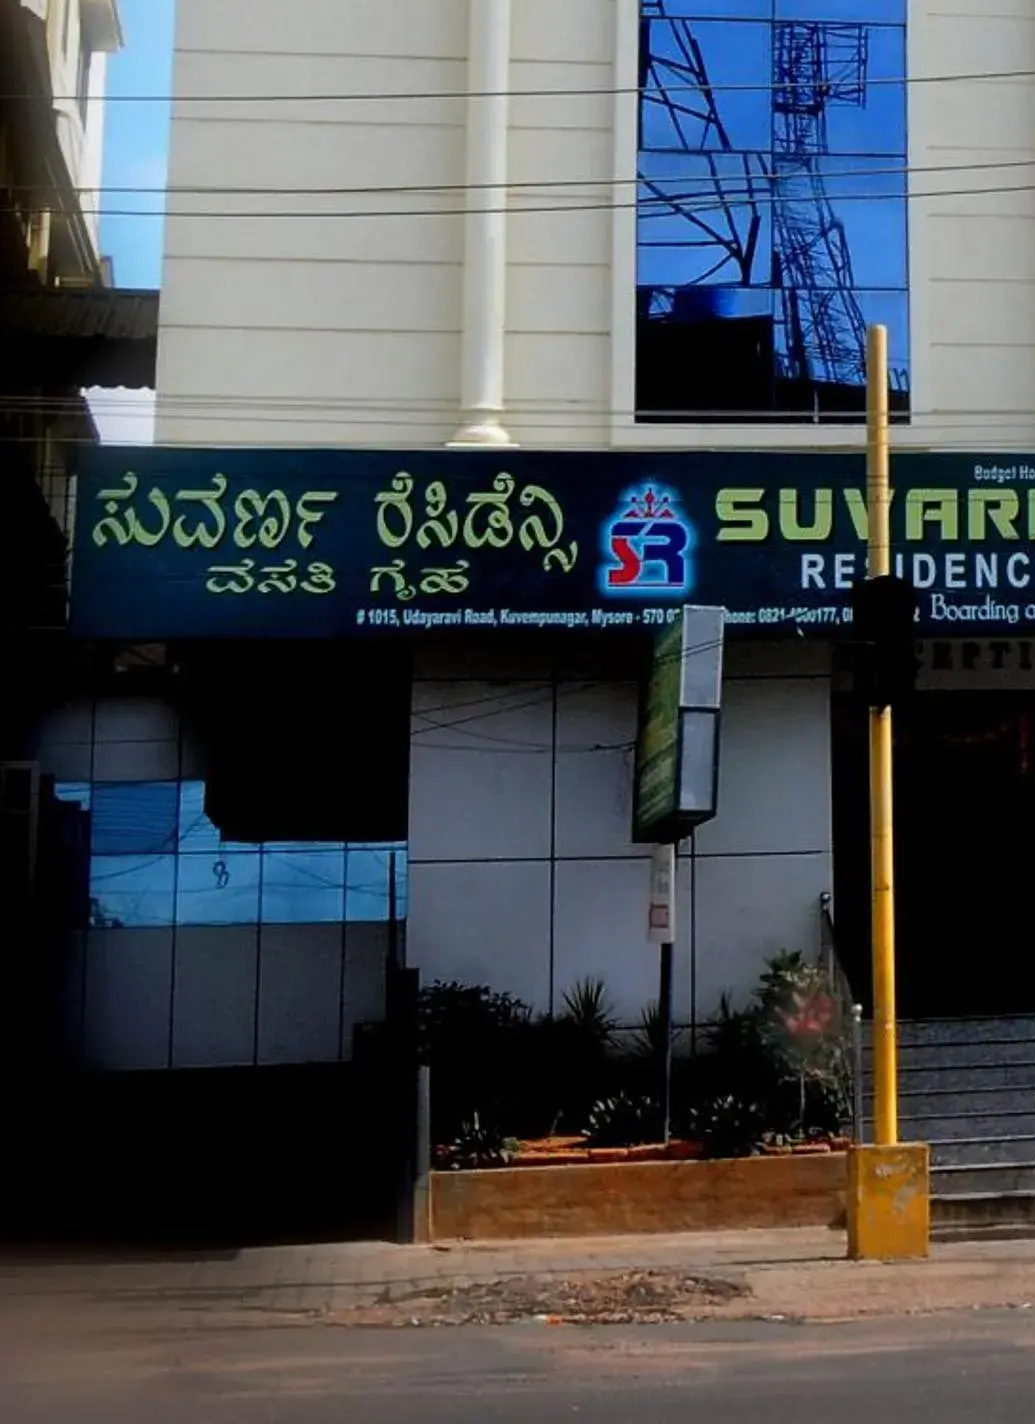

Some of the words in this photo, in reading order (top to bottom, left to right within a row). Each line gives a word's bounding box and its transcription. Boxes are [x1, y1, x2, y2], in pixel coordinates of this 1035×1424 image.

[92, 471, 338, 549] ಸುವರ್ಣ
[206, 559, 337, 593] ವಸತಿ
[368, 609, 400, 627] 1015,
[465, 609, 497, 627] Road,
[592, 609, 633, 627] Mysore
[724, 610, 756, 624] hone:
[930, 594, 1018, 623] Boarding
